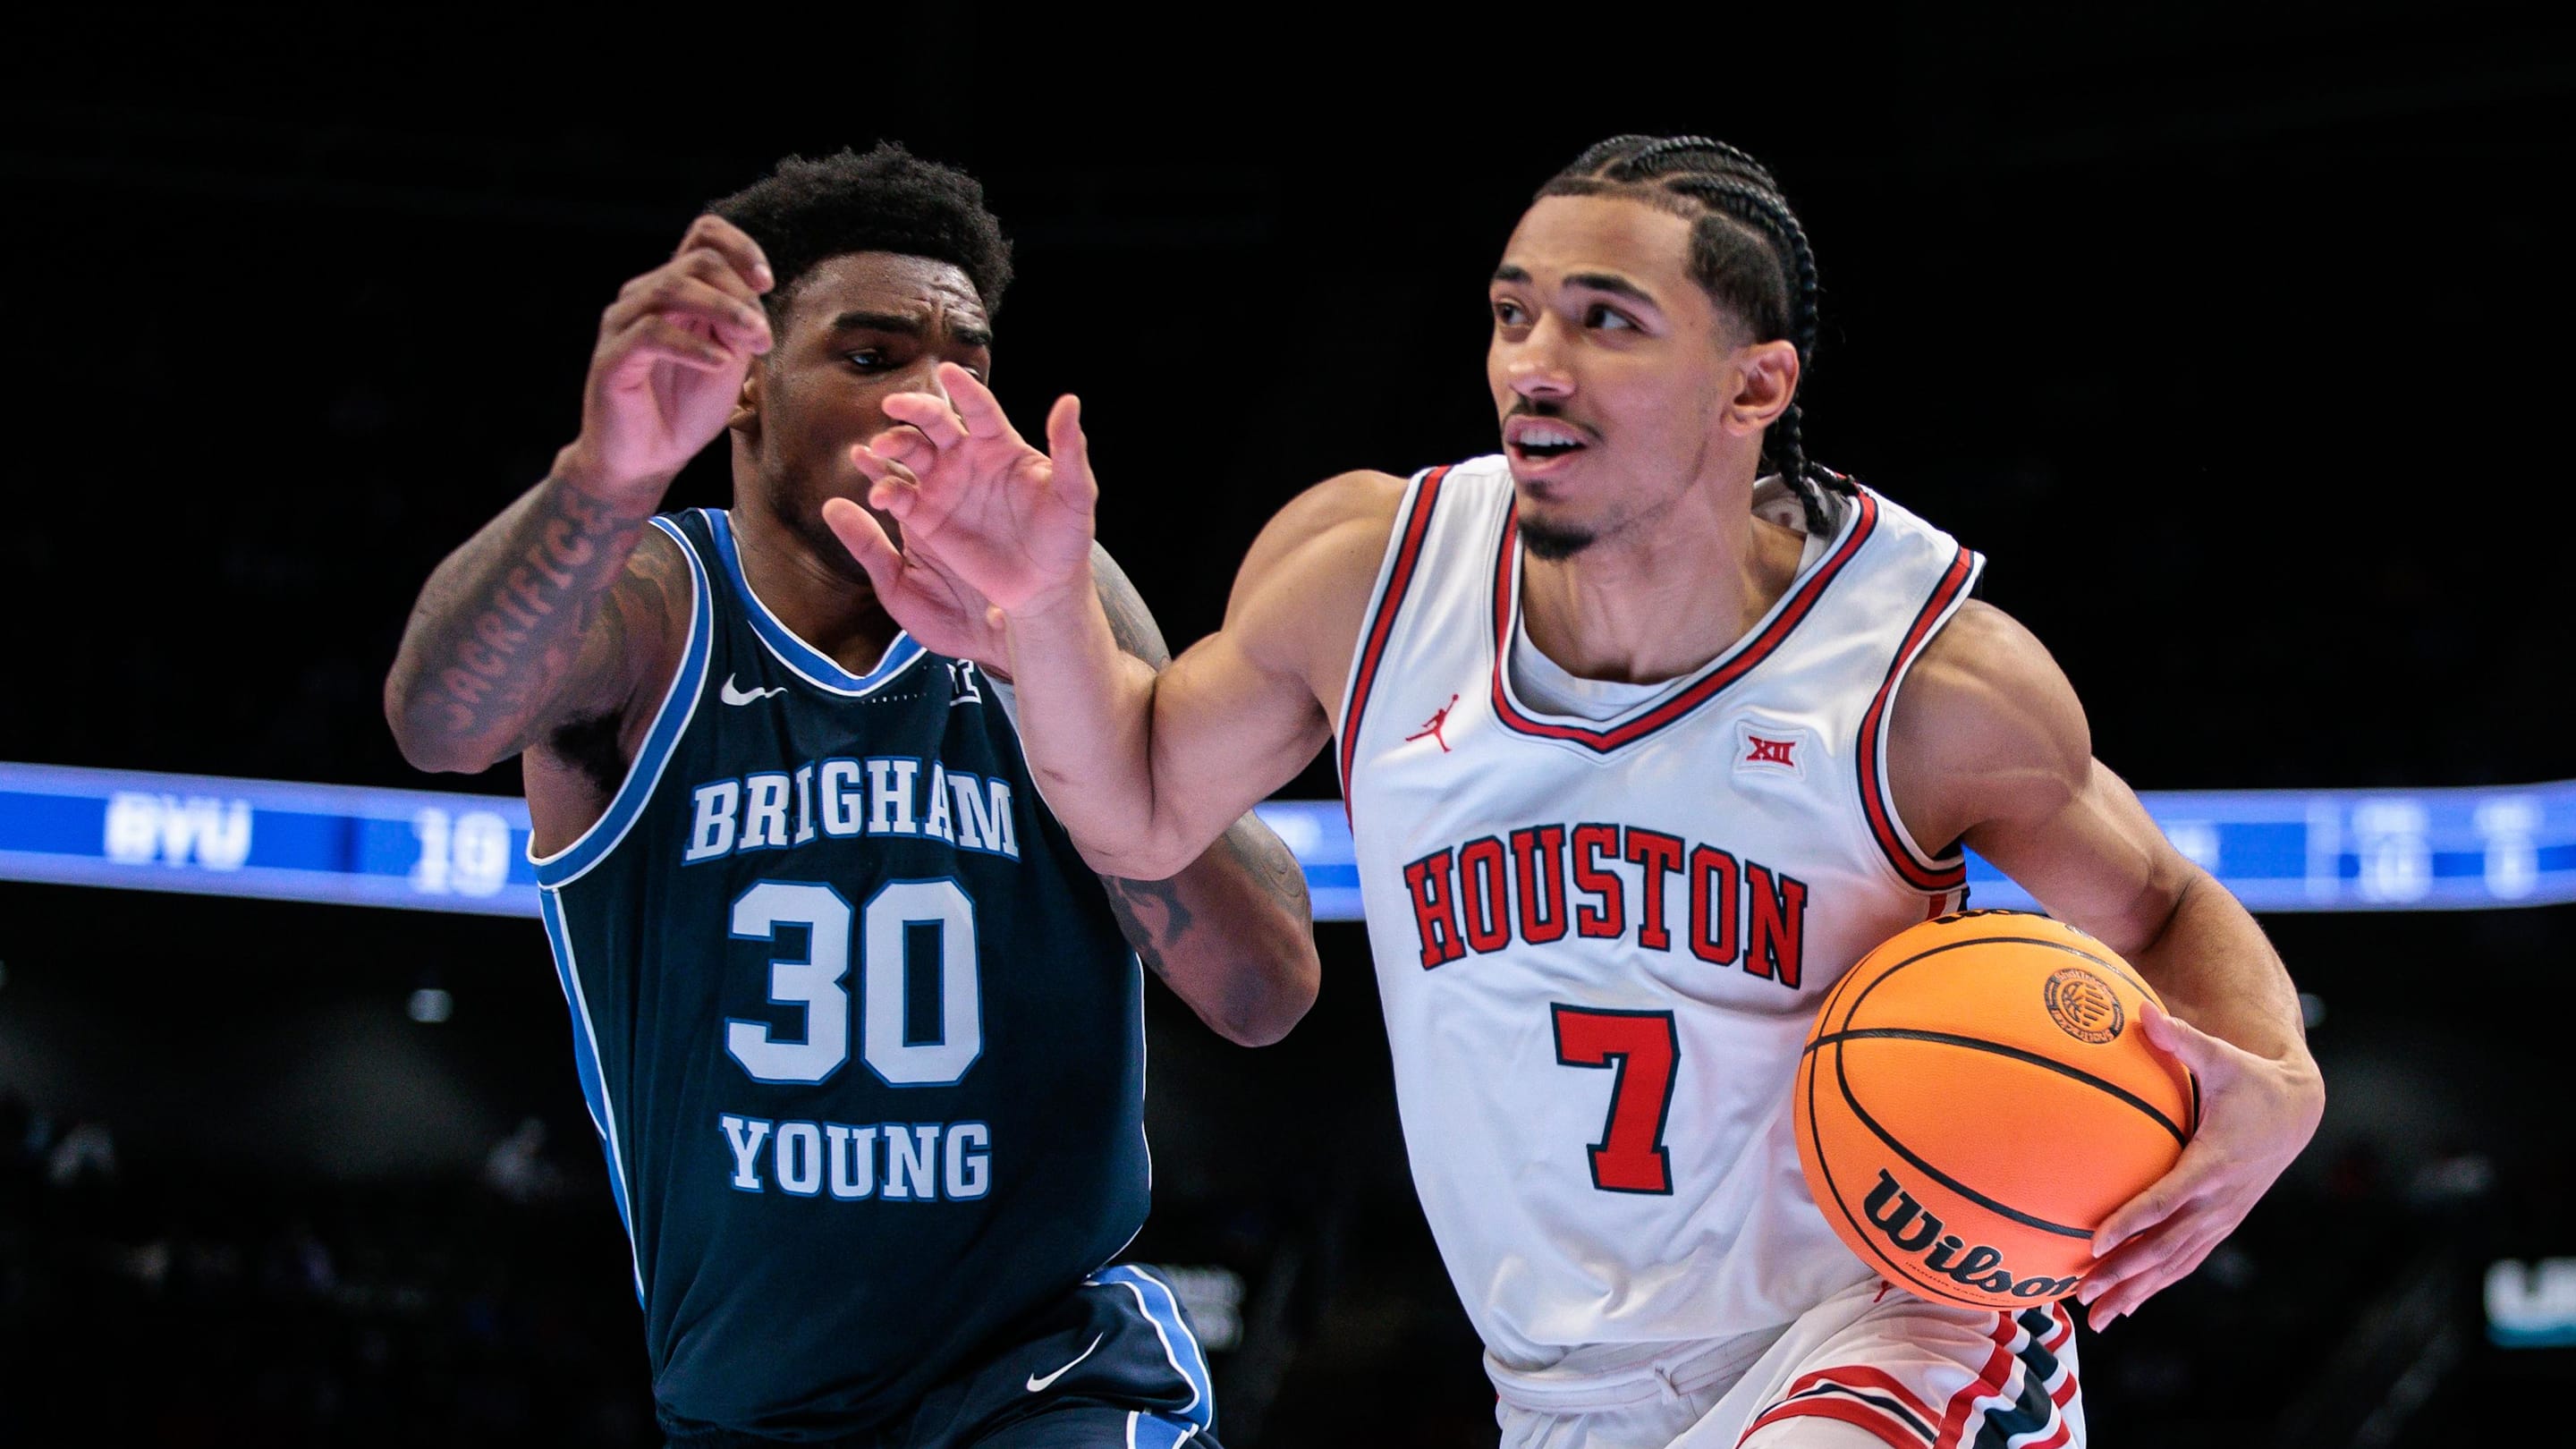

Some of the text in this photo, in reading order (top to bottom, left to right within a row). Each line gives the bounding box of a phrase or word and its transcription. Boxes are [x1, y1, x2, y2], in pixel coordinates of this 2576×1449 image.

[1746, 735, 1796, 767] XII
[104, 792, 252, 871] BYU
[681, 756, 1021, 867] BRIGHAM
[1403, 823, 1809, 990] HOUSTON
[724, 876, 984, 1088] 30
[1550, 1002, 1681, 1196] 7
[719, 1112, 992, 1201] YOUNG
